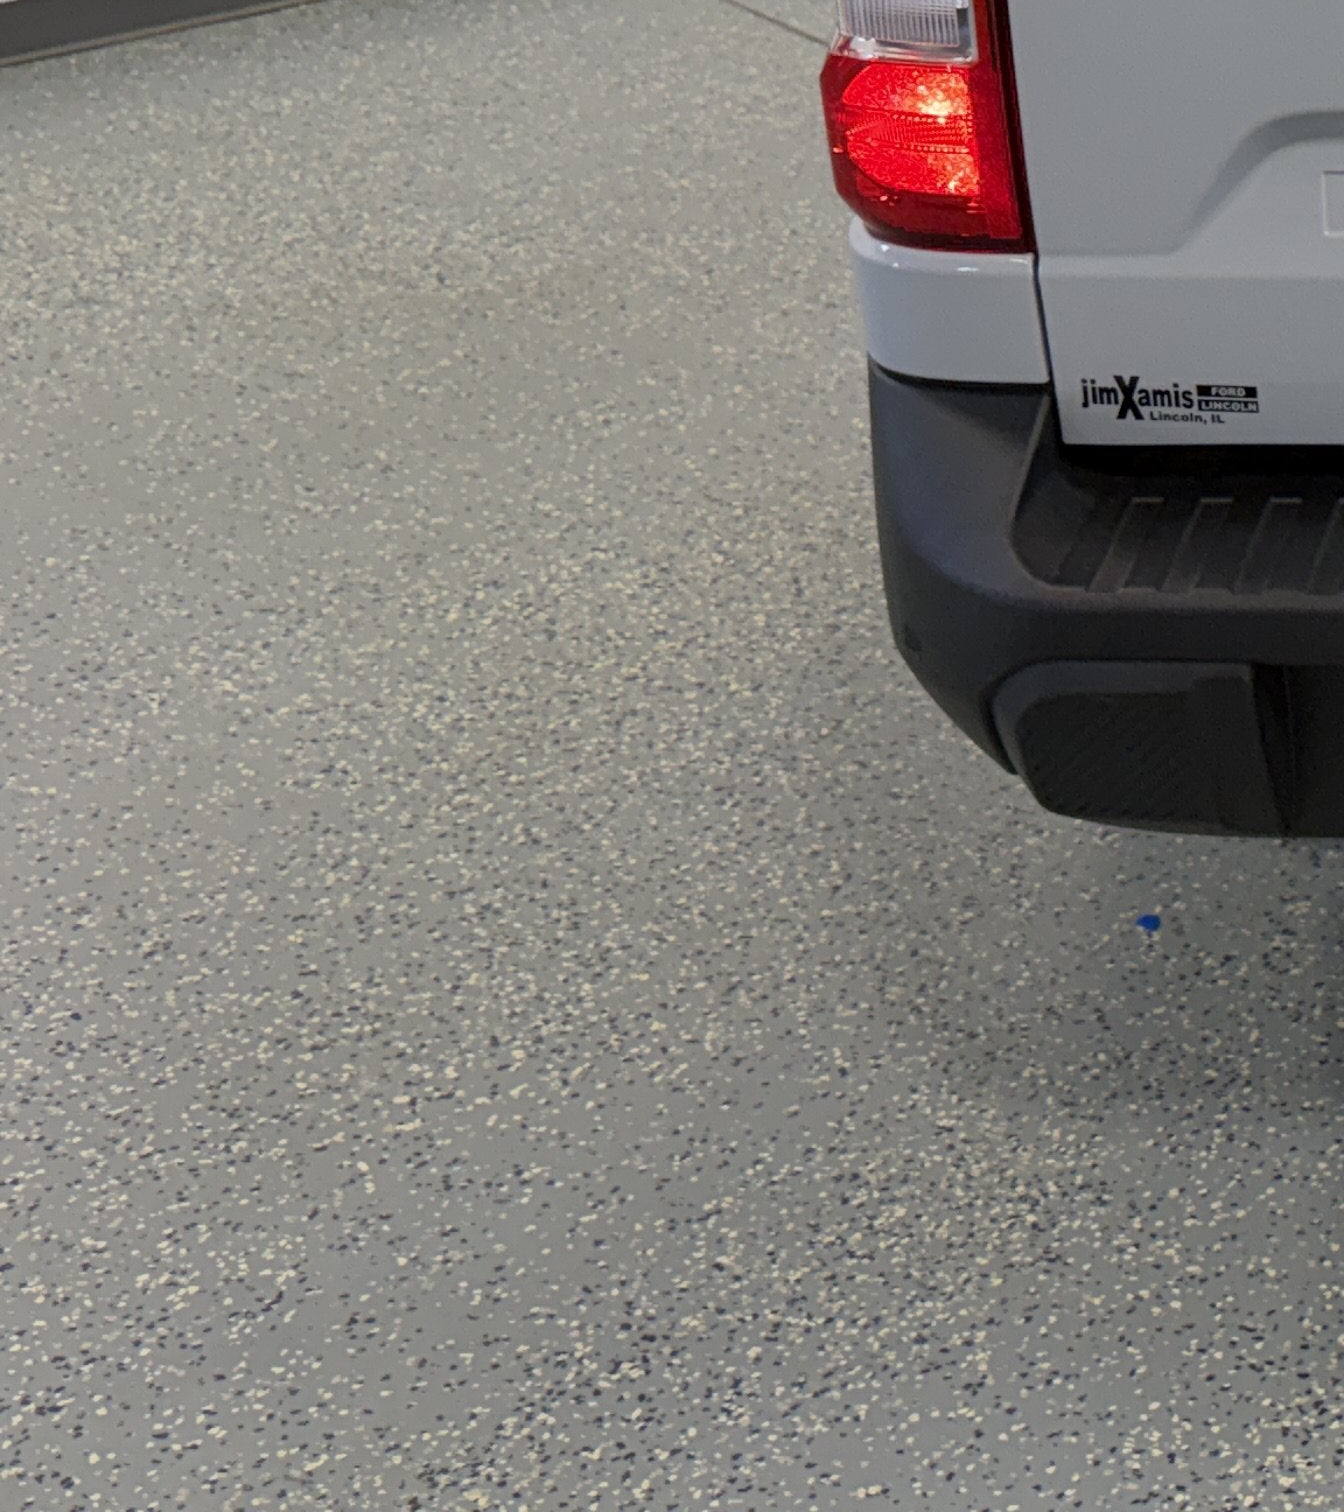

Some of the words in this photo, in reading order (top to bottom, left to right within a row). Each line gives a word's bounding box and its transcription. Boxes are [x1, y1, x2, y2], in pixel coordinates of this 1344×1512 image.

[1211, 387, 1246, 397] FORD
[1201, 401, 1258, 412] LINCOLN
[1149, 411, 1207, 424] Lincoln,
[1211, 414, 1225, 423] IL
